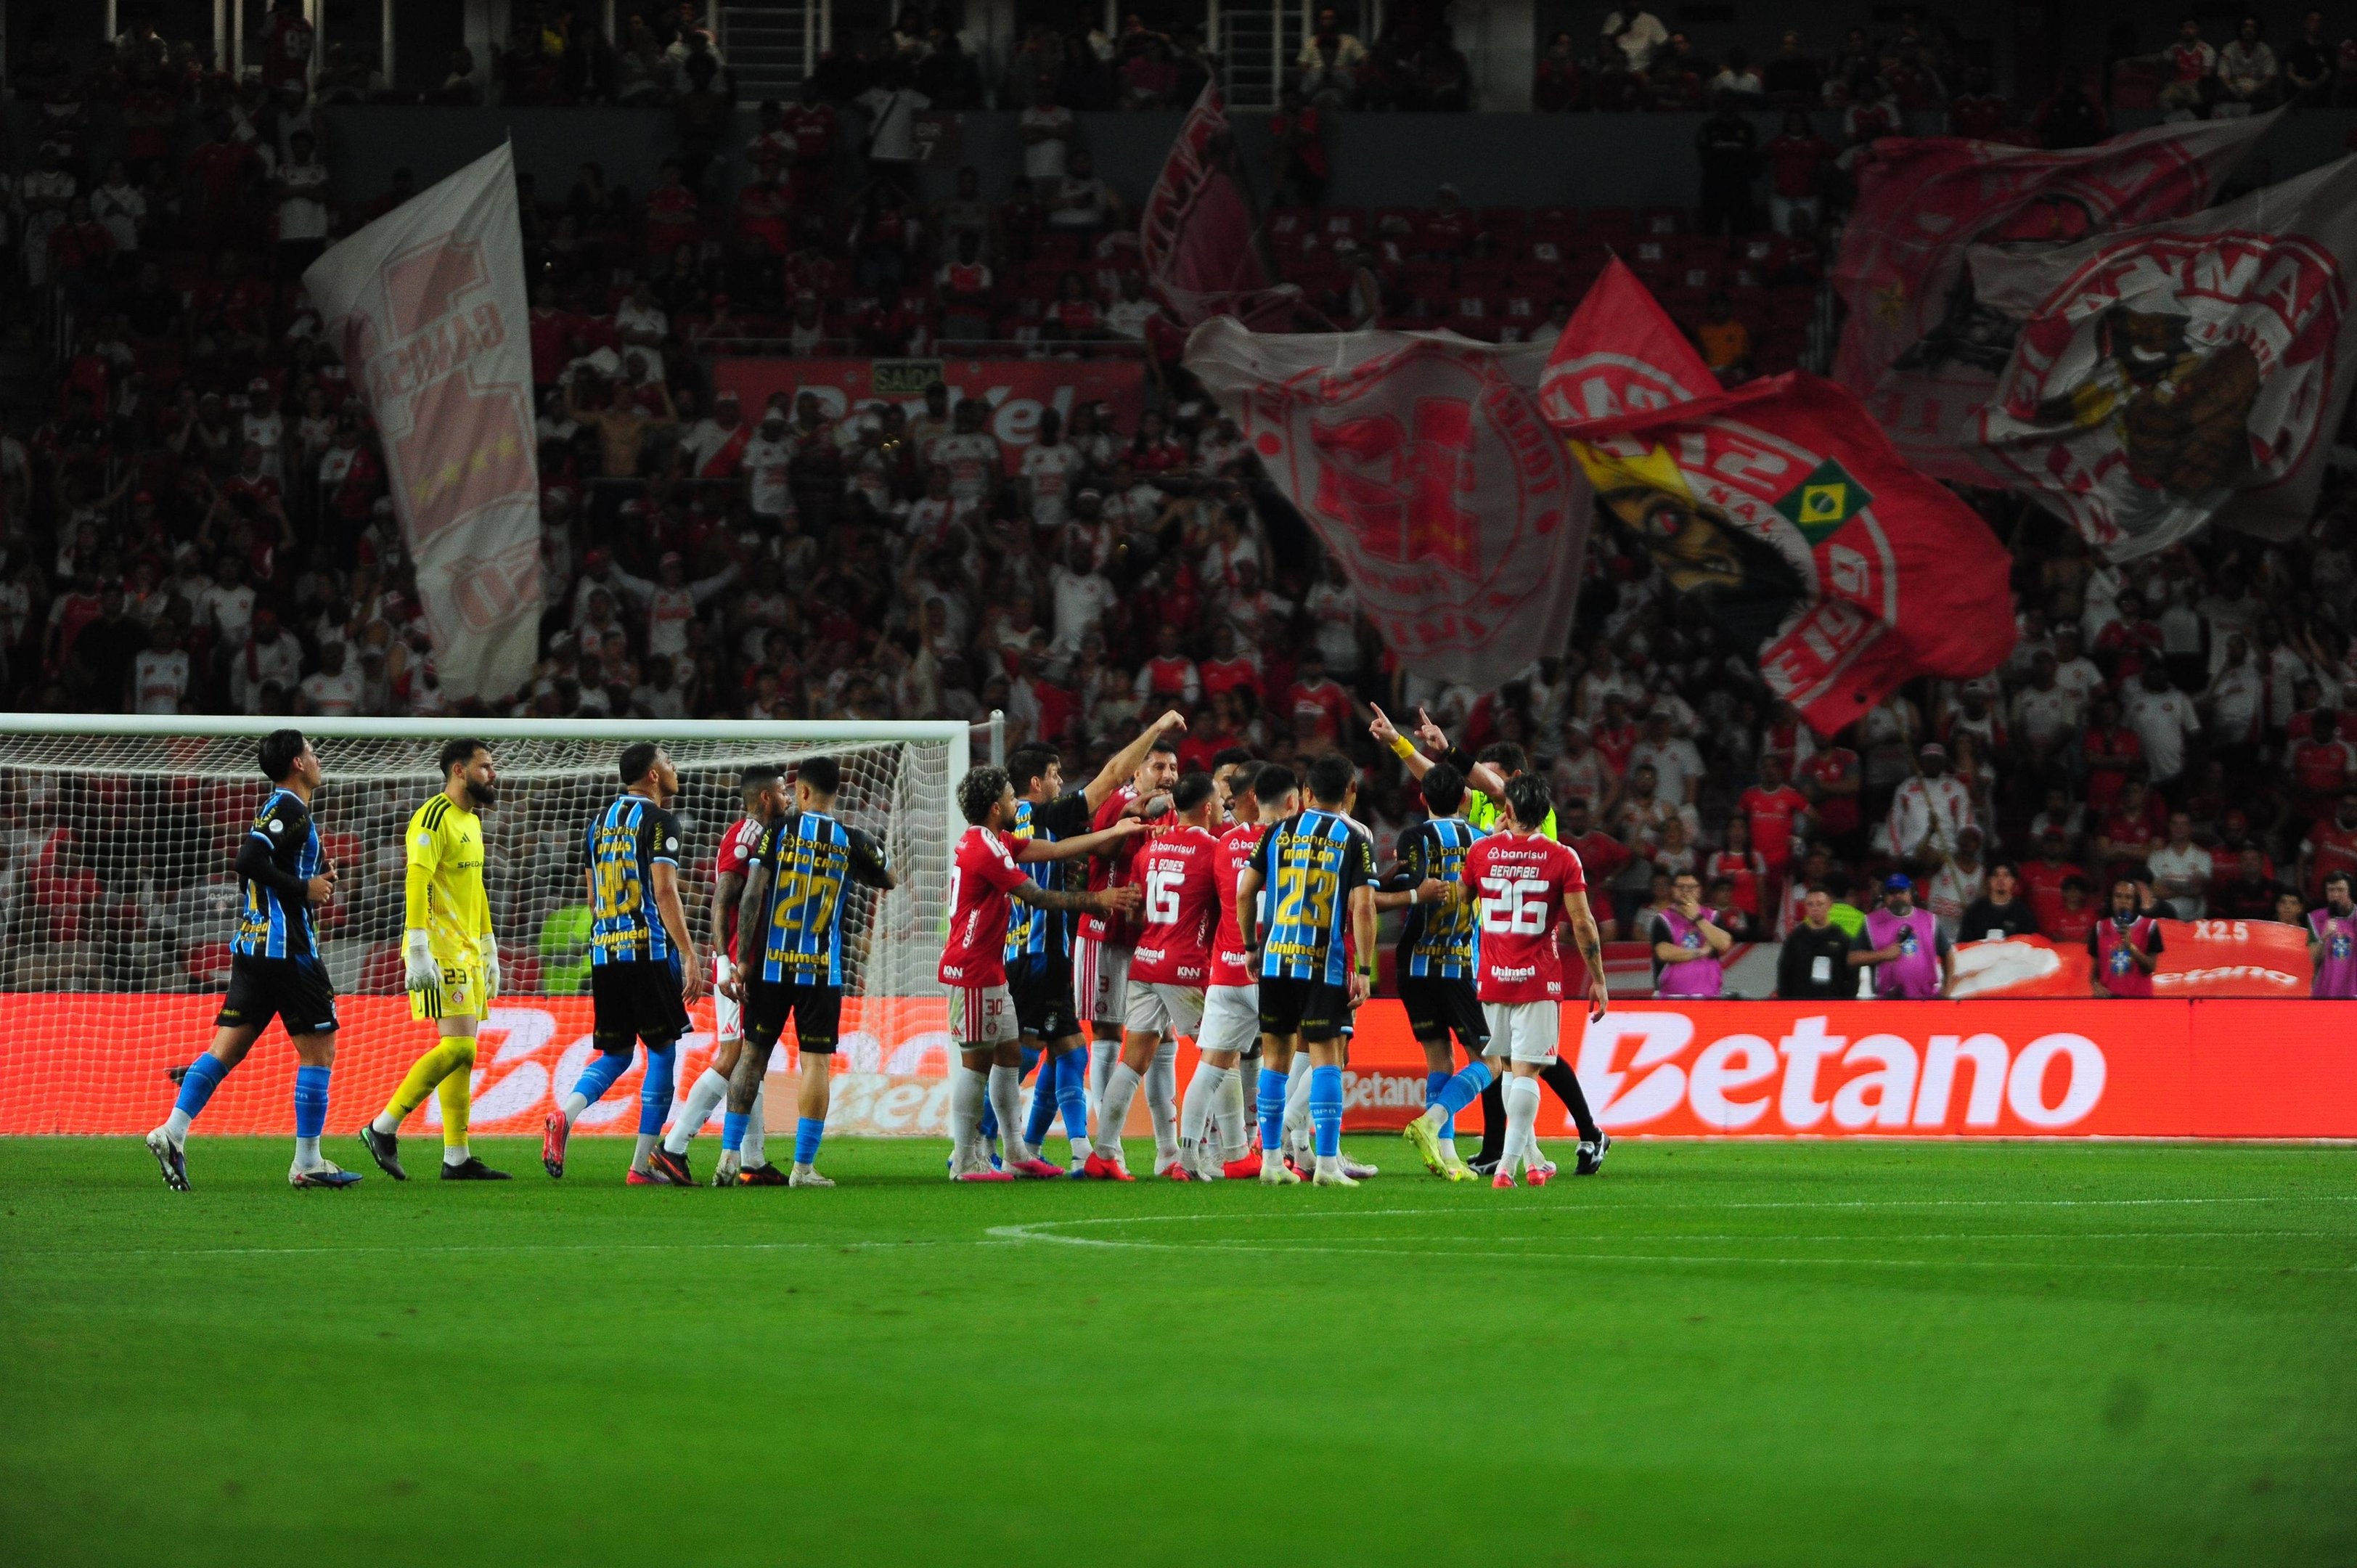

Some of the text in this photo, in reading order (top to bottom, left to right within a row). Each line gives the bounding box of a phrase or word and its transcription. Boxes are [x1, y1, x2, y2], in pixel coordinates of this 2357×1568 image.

[796, 836, 851, 856] banrisul
[1158, 841, 1196, 854] banrisul
[1292, 833, 1348, 850] banrisul
[777, 851, 810, 865] DIEGO
[1283, 849, 1334, 862] MARLON
[1501, 849, 1547, 860] banrisul
[1148, 858, 1185, 873] B. GOMES
[1490, 864, 1540, 878] BERNABEI
[597, 859, 641, 920] 95
[1275, 866, 1337, 929] 23
[773, 870, 840, 934] 27
[1480, 877, 1550, 934] 26
[594, 926, 648, 946] Unimed
[963, 907, 979, 950] CIGAME
[2194, 920, 2249, 941] X2.5
[768, 948, 830, 965] Unimed
[1267, 941, 1326, 958] Unimed
[444, 968, 467, 985] 23
[944, 965, 963, 978] KNN
[1177, 966, 1201, 977] KNN
[1491, 965, 1535, 976] Unimed
[2151, 965, 2299, 987] etano
[1098, 974, 1109, 993] 3
[985, 998, 1003, 1016] 30
[1566, 1011, 2107, 1130] Betano
[1341, 1070, 1427, 1110] Betano
